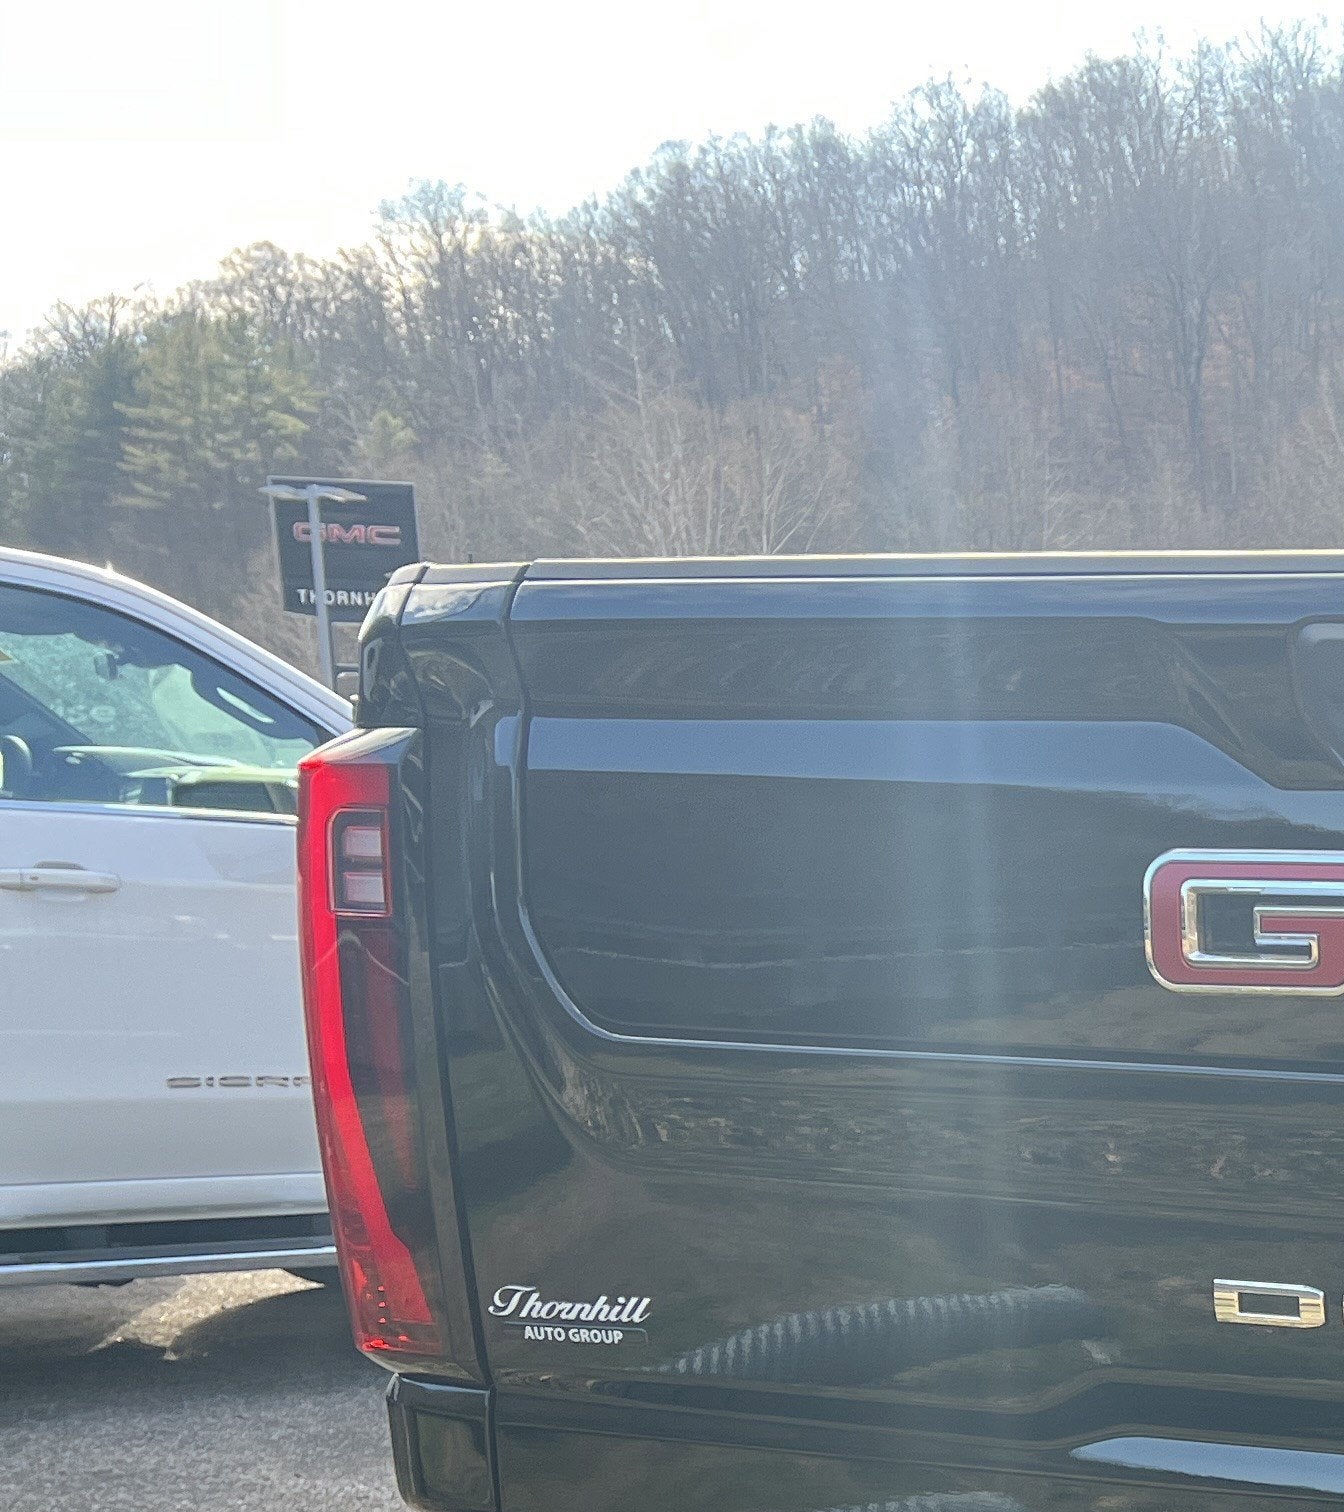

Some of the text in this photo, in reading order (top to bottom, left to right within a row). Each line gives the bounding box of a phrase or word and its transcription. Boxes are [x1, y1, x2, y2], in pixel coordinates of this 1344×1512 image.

[293, 521, 401, 546] GMC
[166, 1076, 312, 1088] SIERR
[487, 1285, 651, 1324] Thornhill
[524, 1326, 624, 1344] AUTO GROUP
